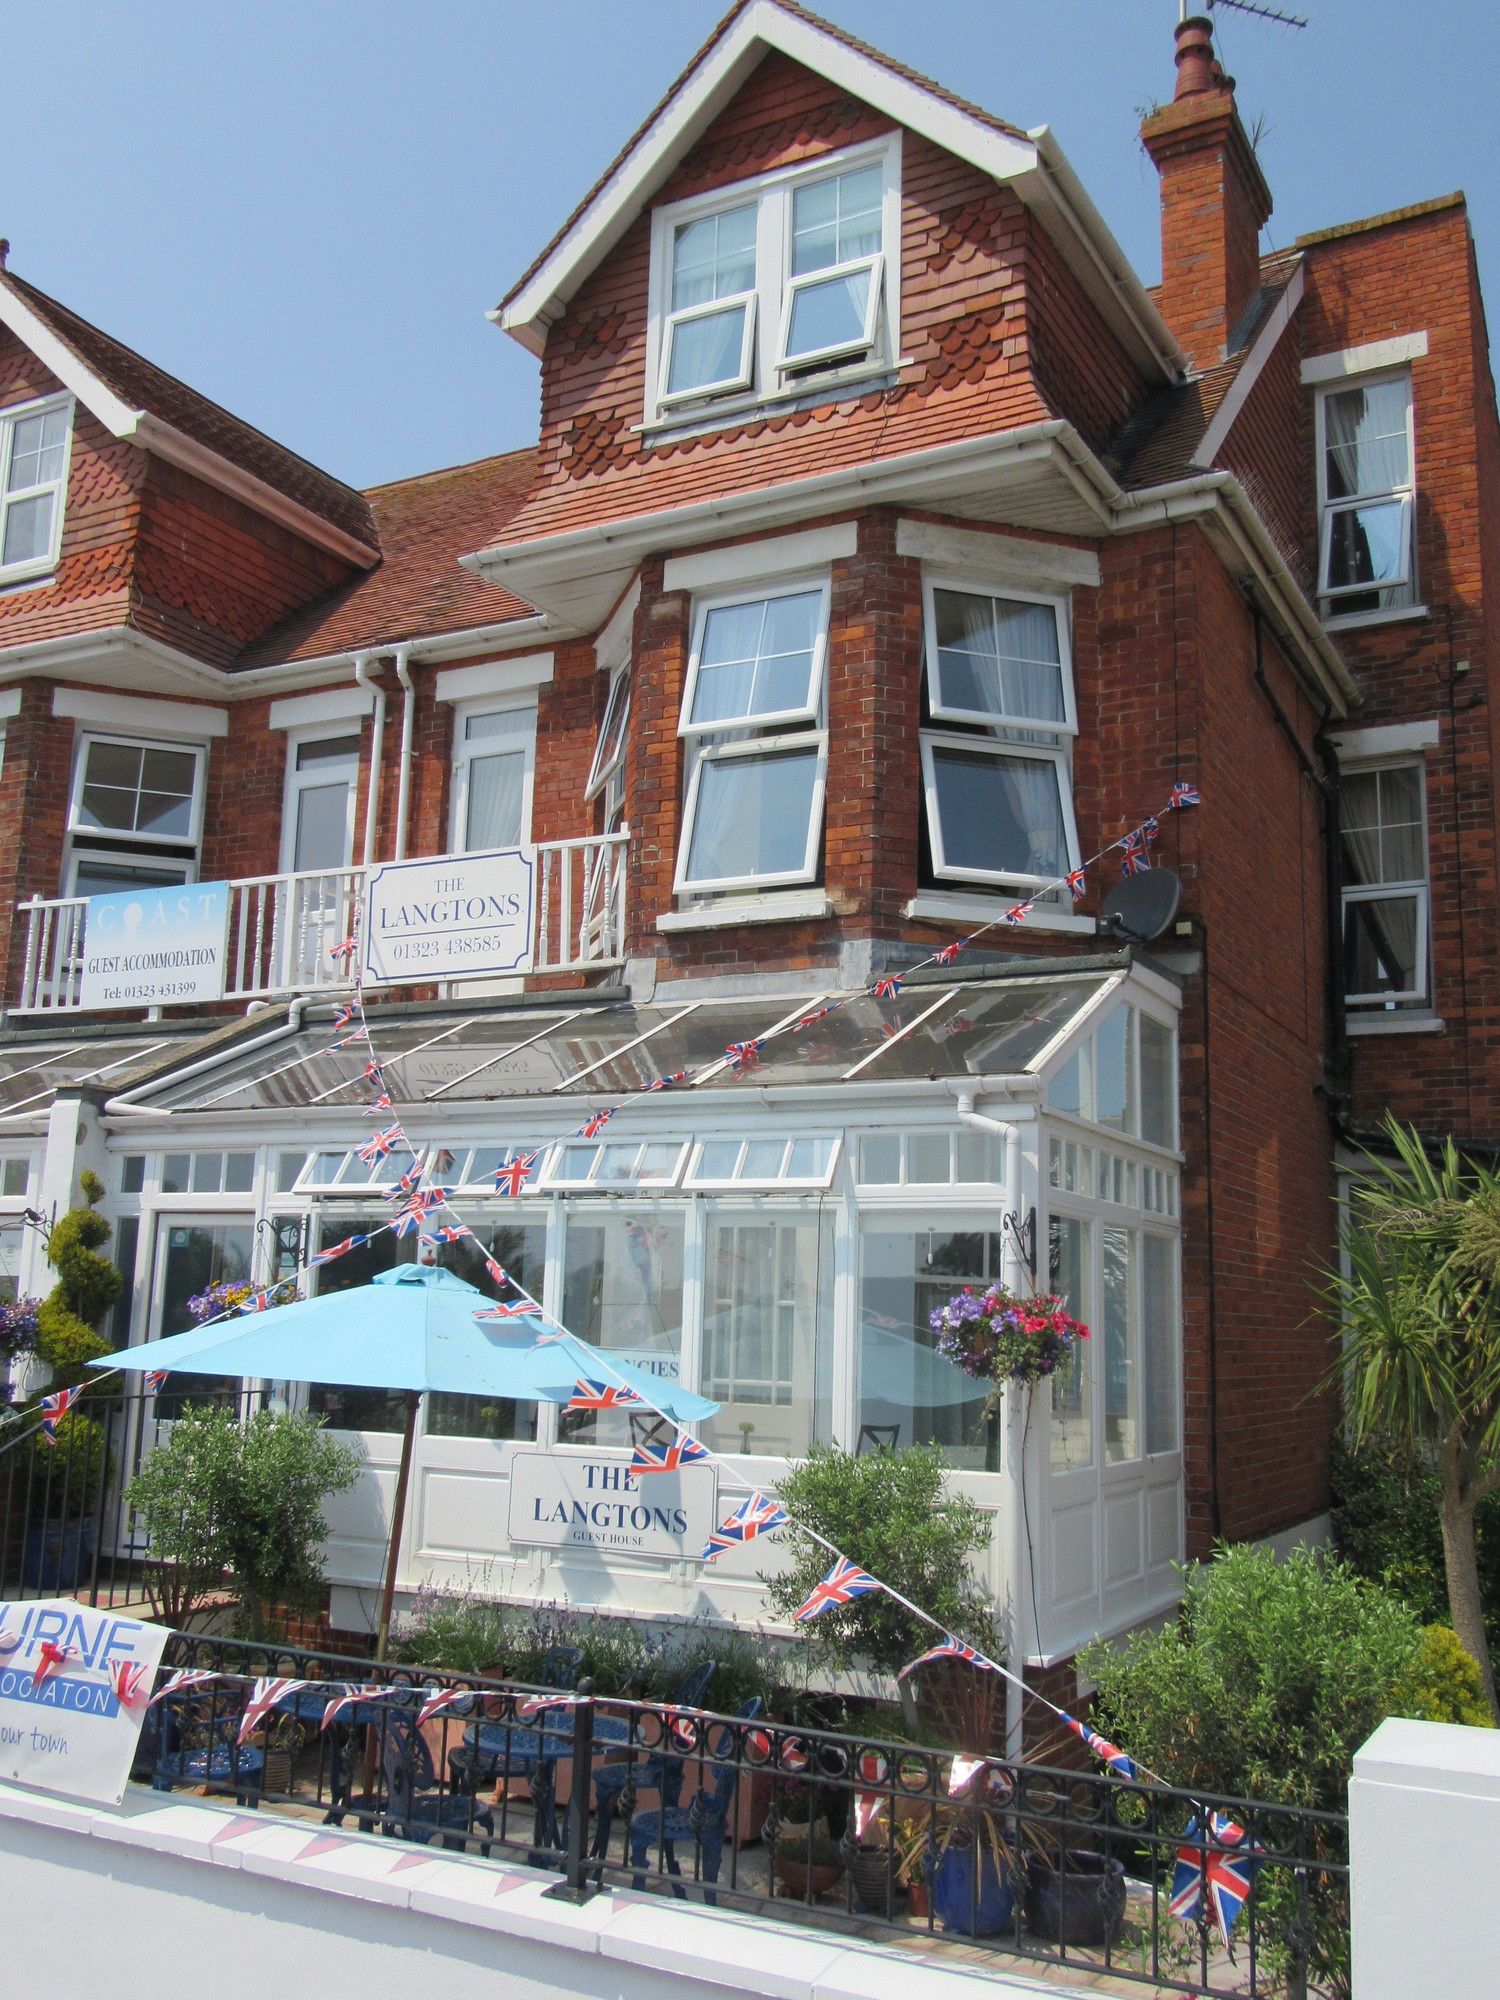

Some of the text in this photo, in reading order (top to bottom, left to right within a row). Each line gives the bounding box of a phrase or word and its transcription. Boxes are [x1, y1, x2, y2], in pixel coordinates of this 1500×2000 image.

[434, 877, 465, 893] THE
[381, 893, 520, 929] LANGTONS
[394, 935, 501, 960] 01323 438585
[88, 948, 217, 975] GUEST ACCOMMODATION
[103, 981, 196, 999] Tel: 01323 431399
[582, 1465, 639, 1492] THE
[533, 1497, 688, 1535] LANGTONS
[573, 1531, 644, 1546] GUEST HOUSE
[30, 1725, 68, 1755] town
